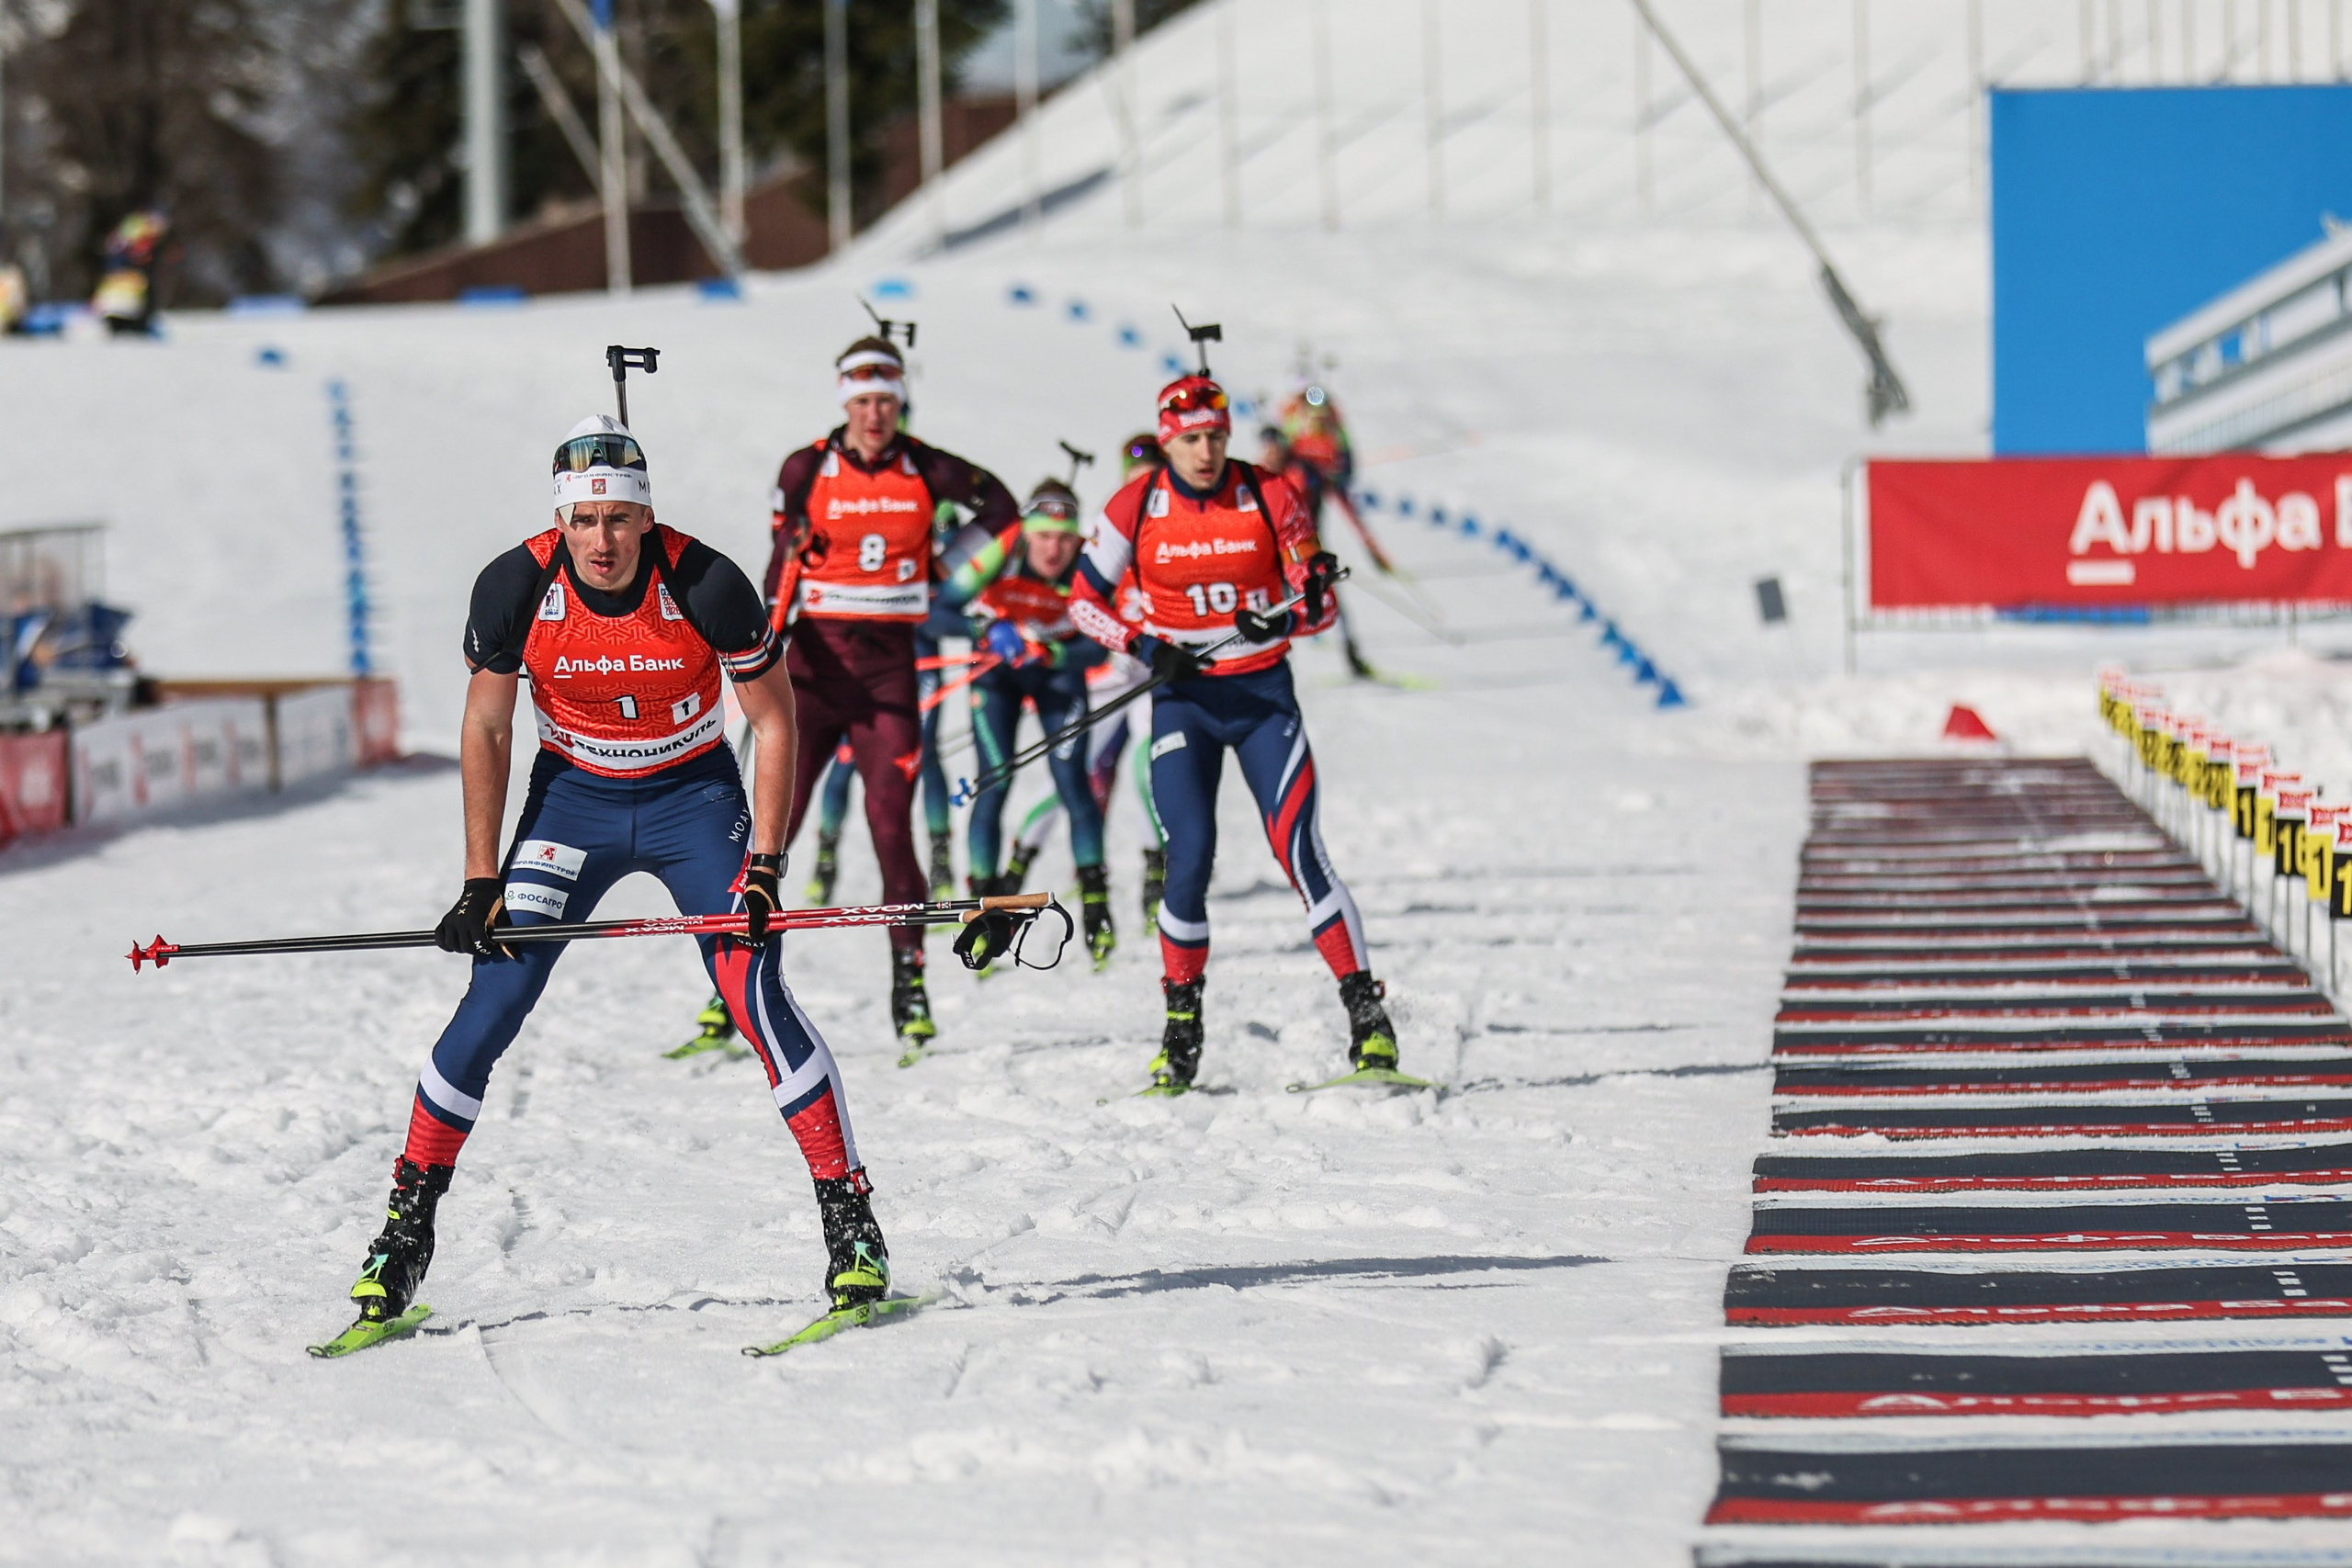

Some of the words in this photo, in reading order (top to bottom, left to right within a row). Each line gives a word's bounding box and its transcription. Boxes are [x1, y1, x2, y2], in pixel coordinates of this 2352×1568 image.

[2067, 476, 2324, 572] Альфа
[858, 533, 887, 572] 8
[1155, 540, 1213, 561] Альфа
[1213, 537, 1258, 555] Банк
[1185, 581, 1238, 617] 10
[553, 654, 626, 677] Альфа
[629, 654, 685, 672] Банк
[613, 694, 639, 720] 1
[681, 700, 690, 716] 1
[2238, 792, 2253, 837] 1
[2312, 842, 2325, 891] 1
[517, 892, 564, 909] ФОСАГРО
[2336, 859, 2352, 916] 1
[841, 903, 924, 915] MOAX
[624, 925, 684, 933] MOAX
